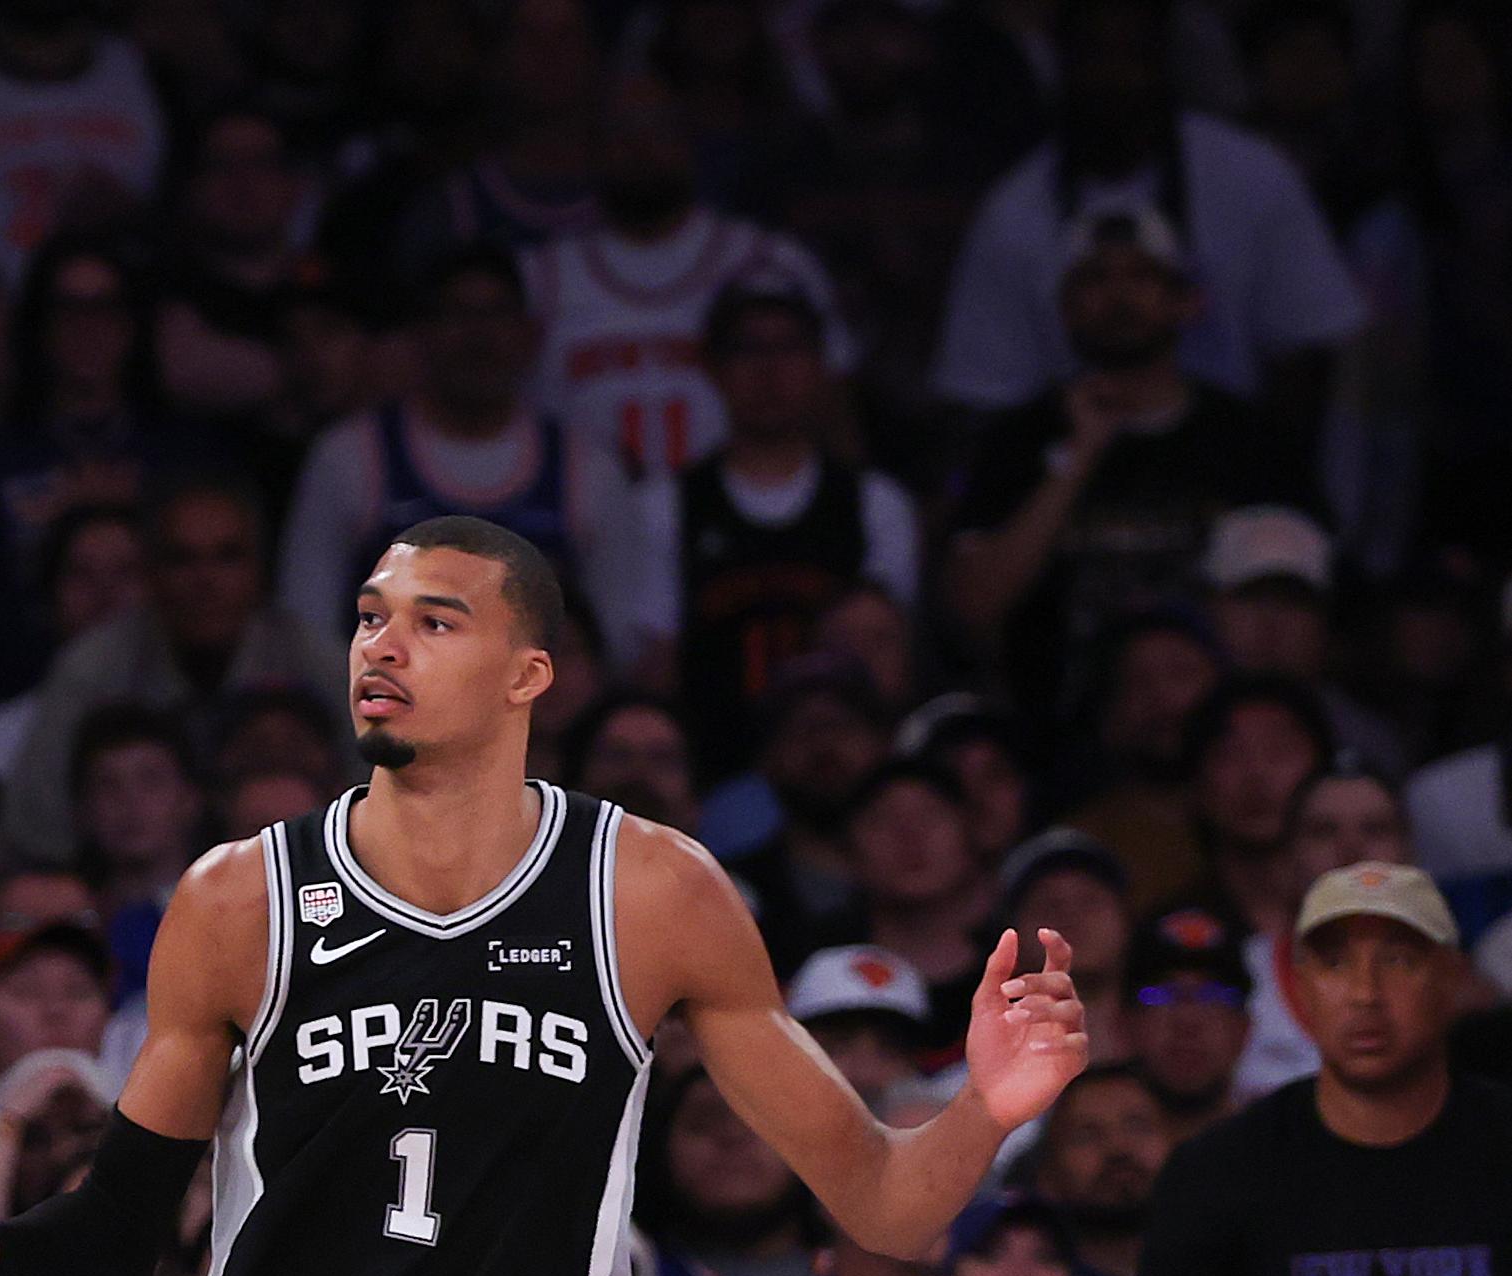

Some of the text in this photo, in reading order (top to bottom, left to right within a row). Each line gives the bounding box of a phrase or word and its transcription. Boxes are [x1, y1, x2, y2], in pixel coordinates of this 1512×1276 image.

[498, 948, 562, 964] LEDGER
[295, 998, 589, 1106] SPURS
[382, 1127, 442, 1248] 1
